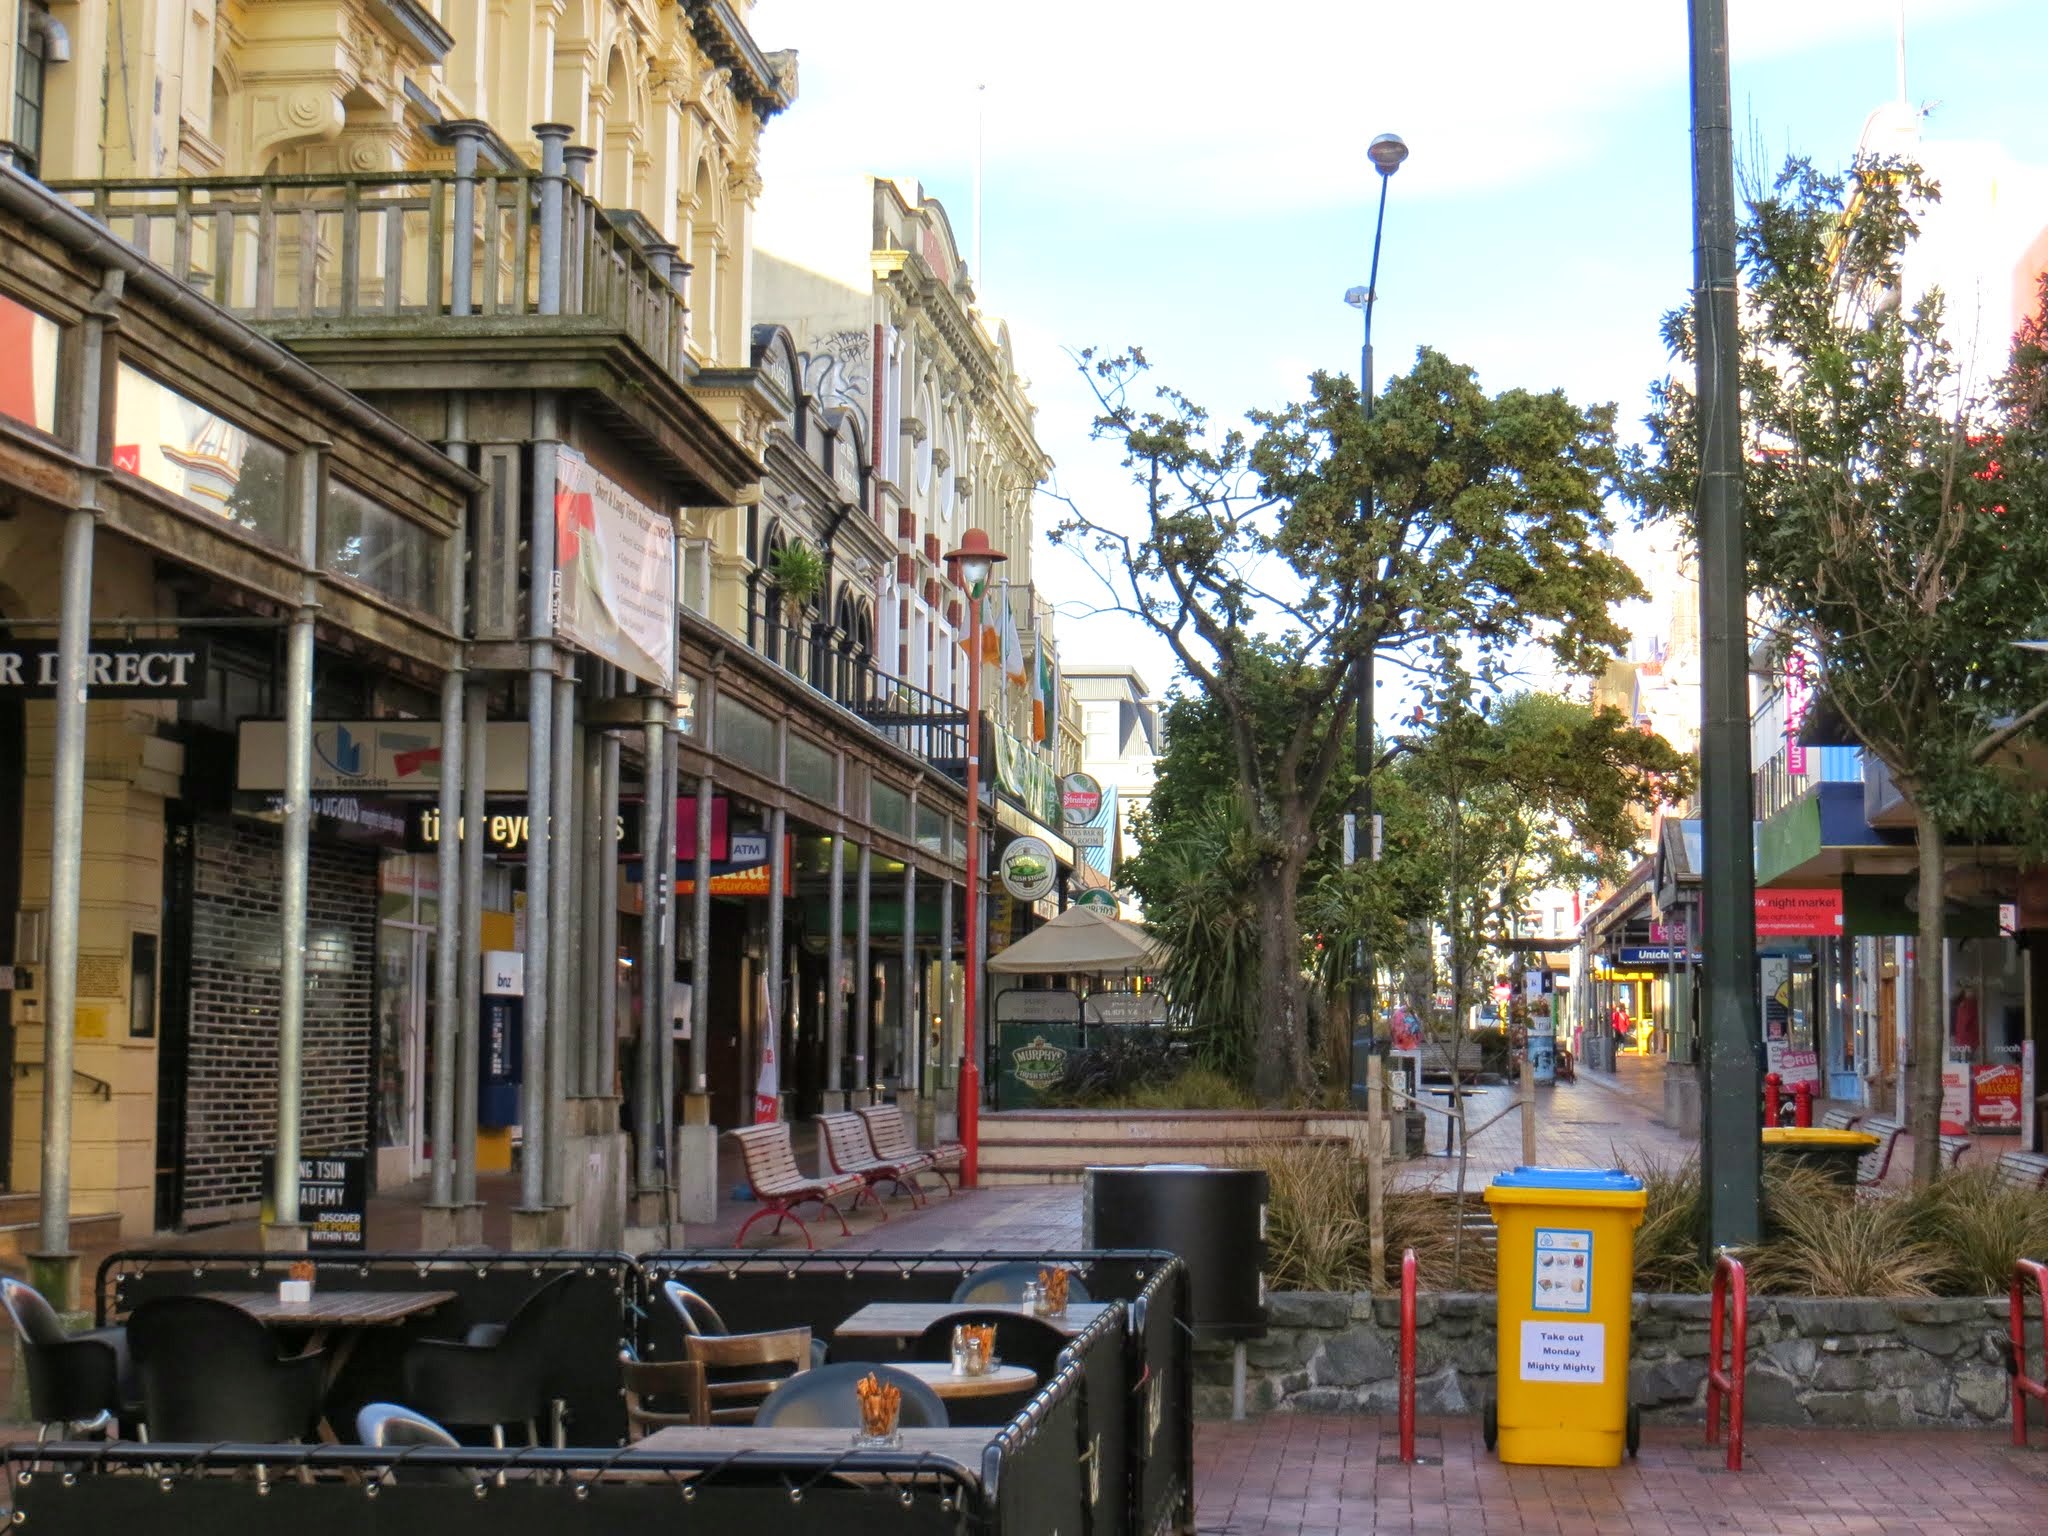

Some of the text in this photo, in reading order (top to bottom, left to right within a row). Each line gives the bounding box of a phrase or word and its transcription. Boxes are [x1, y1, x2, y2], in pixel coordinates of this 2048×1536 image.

[37, 651, 195, 687] DRECT
[733, 844, 760, 855] ATM
[688, 880, 767, 891] rtaurant
[1768, 897, 1795, 909] night
[1798, 897, 1836, 907] market
[497, 973, 511, 988] bnz
[299, 1161, 345, 1179] NG TSUN
[300, 1188, 345, 1206] ADEMY
[319, 1213, 361, 1222] DISCOVER
[313, 1222, 361, 1231] THE POWER
[312, 1231, 361, 1241] WITHIN YOU
[1541, 1332, 1584, 1342] Take out
[1543, 1347, 1581, 1357] Monday
[1528, 1361, 1596, 1373] Mighty Mighty
